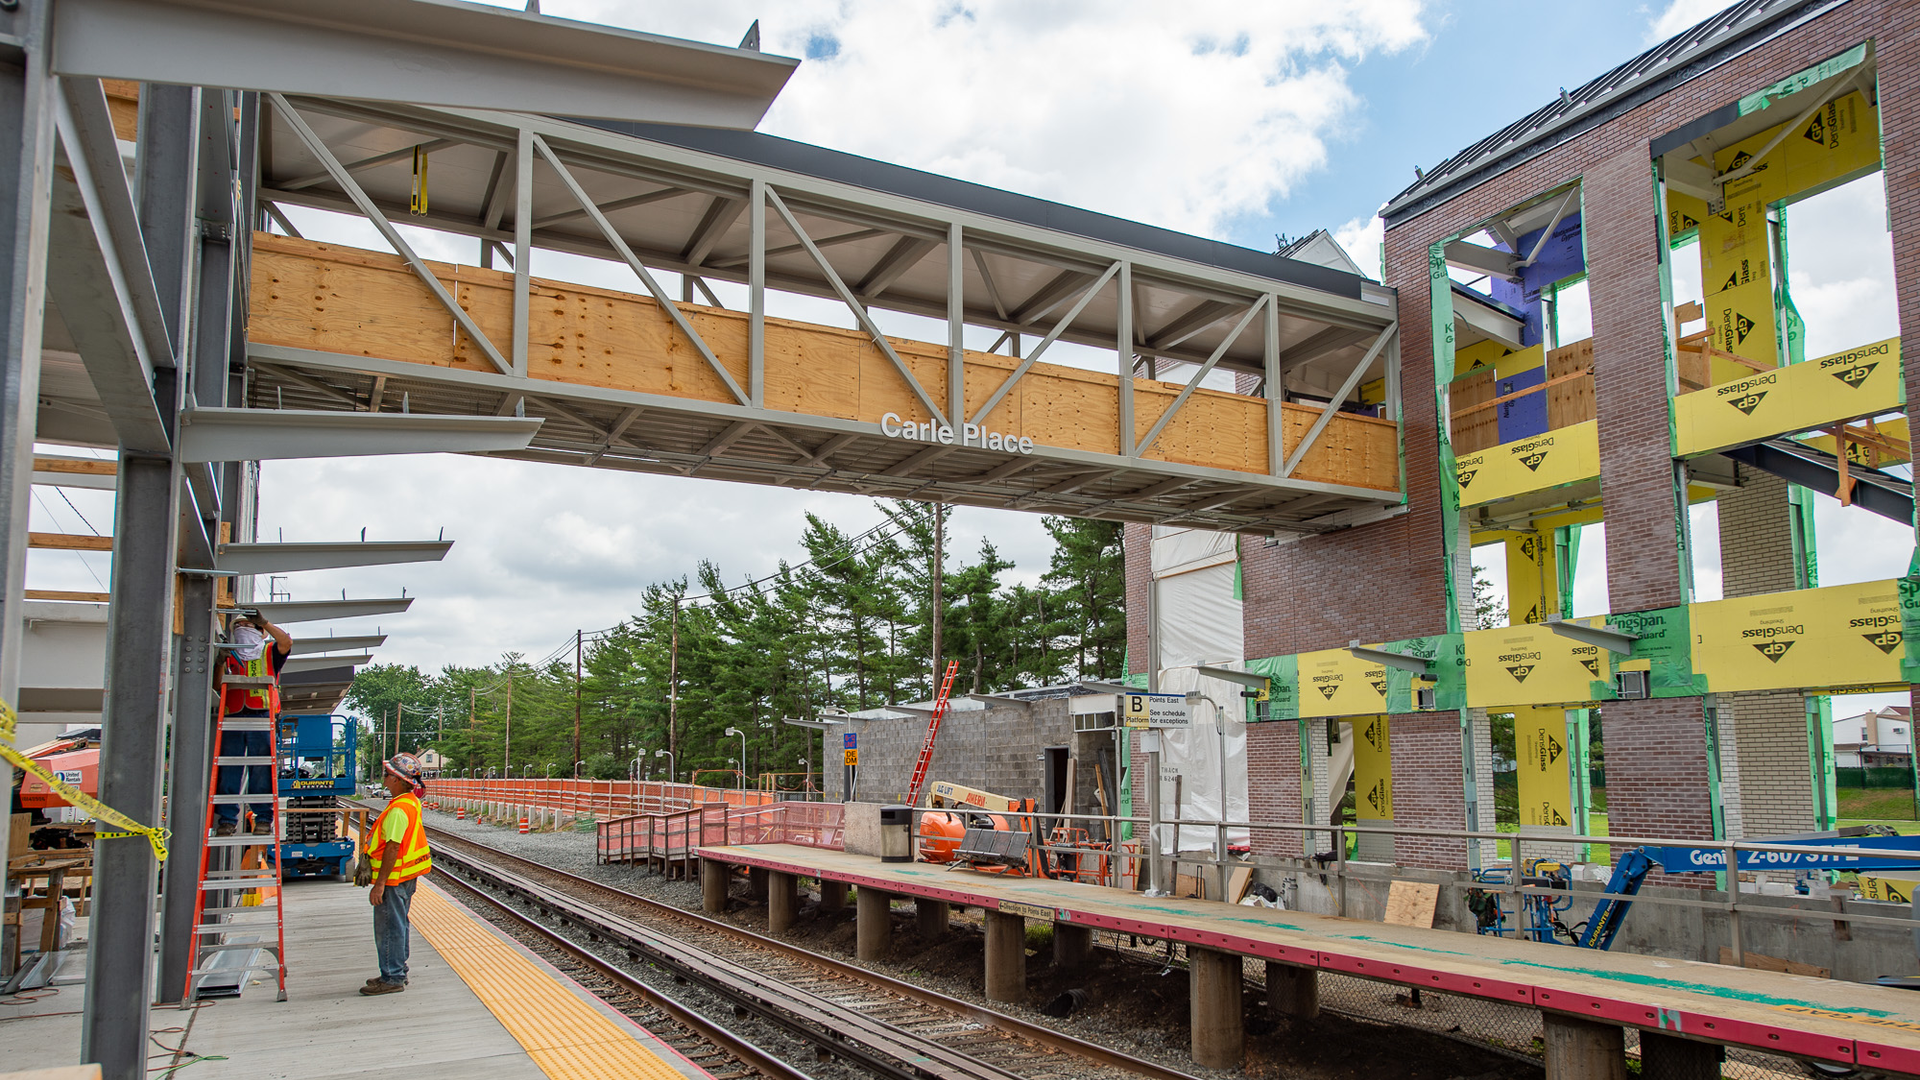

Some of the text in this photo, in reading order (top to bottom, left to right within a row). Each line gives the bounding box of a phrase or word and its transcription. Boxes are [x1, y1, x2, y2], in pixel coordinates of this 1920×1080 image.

[1738, 317, 1748, 336] GP
[1819, 344, 1889, 370] DensGlass
[1843, 367, 1869, 382] GP
[1717, 374, 1777, 397] DensGlass
[1737, 395, 1761, 409] GP
[880, 412, 1034, 455] Carle Place
[1511, 437, 1555, 456] DensGlass
[1525, 454, 1543, 466] GP
[1525, 540, 1534, 556] GP
[1741, 624, 1804, 639] DensGlass
[1874, 633, 1901, 645] GP
[1763, 643, 1787, 655] GP
[1498, 651, 1541, 663] DensGlass
[1312, 674, 1343, 684] DensGlass
[1513, 666, 1529, 677] GP
[1323, 687, 1335, 695] GP
[1131, 695, 1143, 712] B
[1167, 696, 1179, 704] East
[1539, 728, 1548, 773] DensGlass
[1551, 740, 1558, 758] GP
[1040, 909, 1052, 917] East
[1588, 910, 1610, 948] DURANTE
